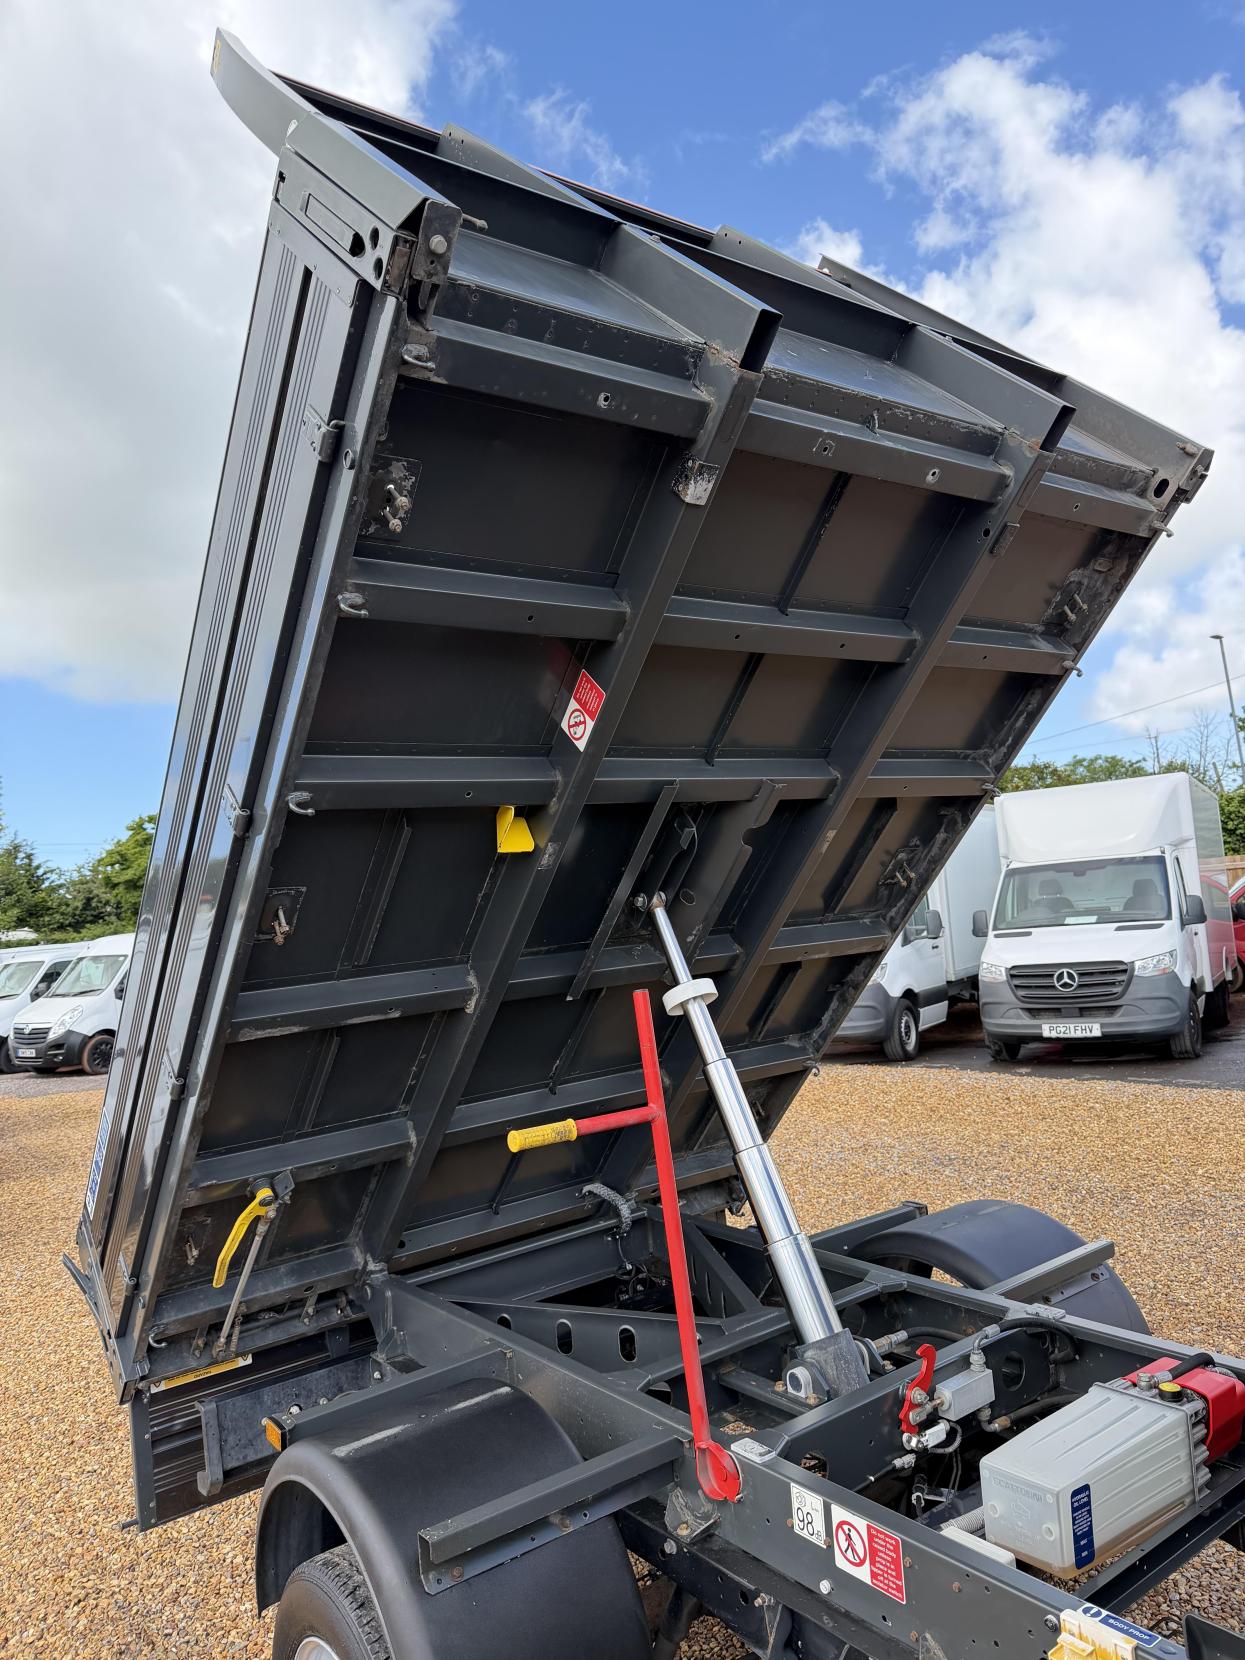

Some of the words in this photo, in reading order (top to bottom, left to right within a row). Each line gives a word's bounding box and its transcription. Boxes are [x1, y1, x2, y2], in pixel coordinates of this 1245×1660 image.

[1048, 1025, 1071, 1035] PG21
[1073, 1024, 1093, 1034] FHV
[796, 1506, 815, 1537] 98
[873, 1537, 886, 1547] under
[872, 1542, 886, 1552] raised
[885, 1547, 897, 1559] body
[877, 1551, 892, 1562] unless
[875, 1562, 887, 1572] place
[870, 1565, 883, 1576] tipper
[887, 1573, 902, 1586] turned
[888, 1587, 903, 1599] switch
[1107, 1618, 1129, 1630] BODY
[1128, 1628, 1150, 1640] PROP
